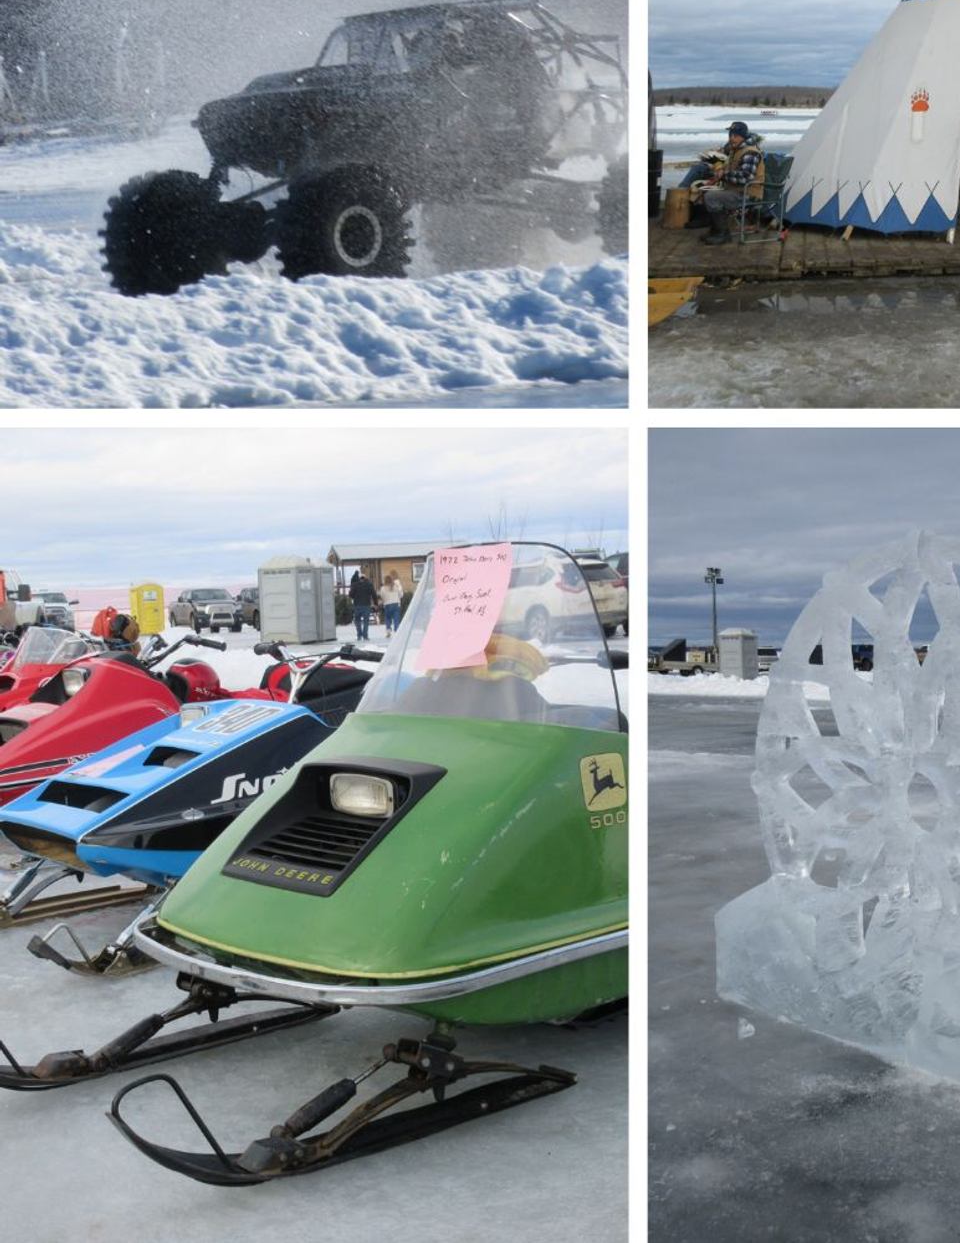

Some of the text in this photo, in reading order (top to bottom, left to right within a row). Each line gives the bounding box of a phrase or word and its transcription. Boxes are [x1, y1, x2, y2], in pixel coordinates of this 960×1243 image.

[590, 810, 626, 829] 500
[232, 858, 334, 885] JOHN DEERE
